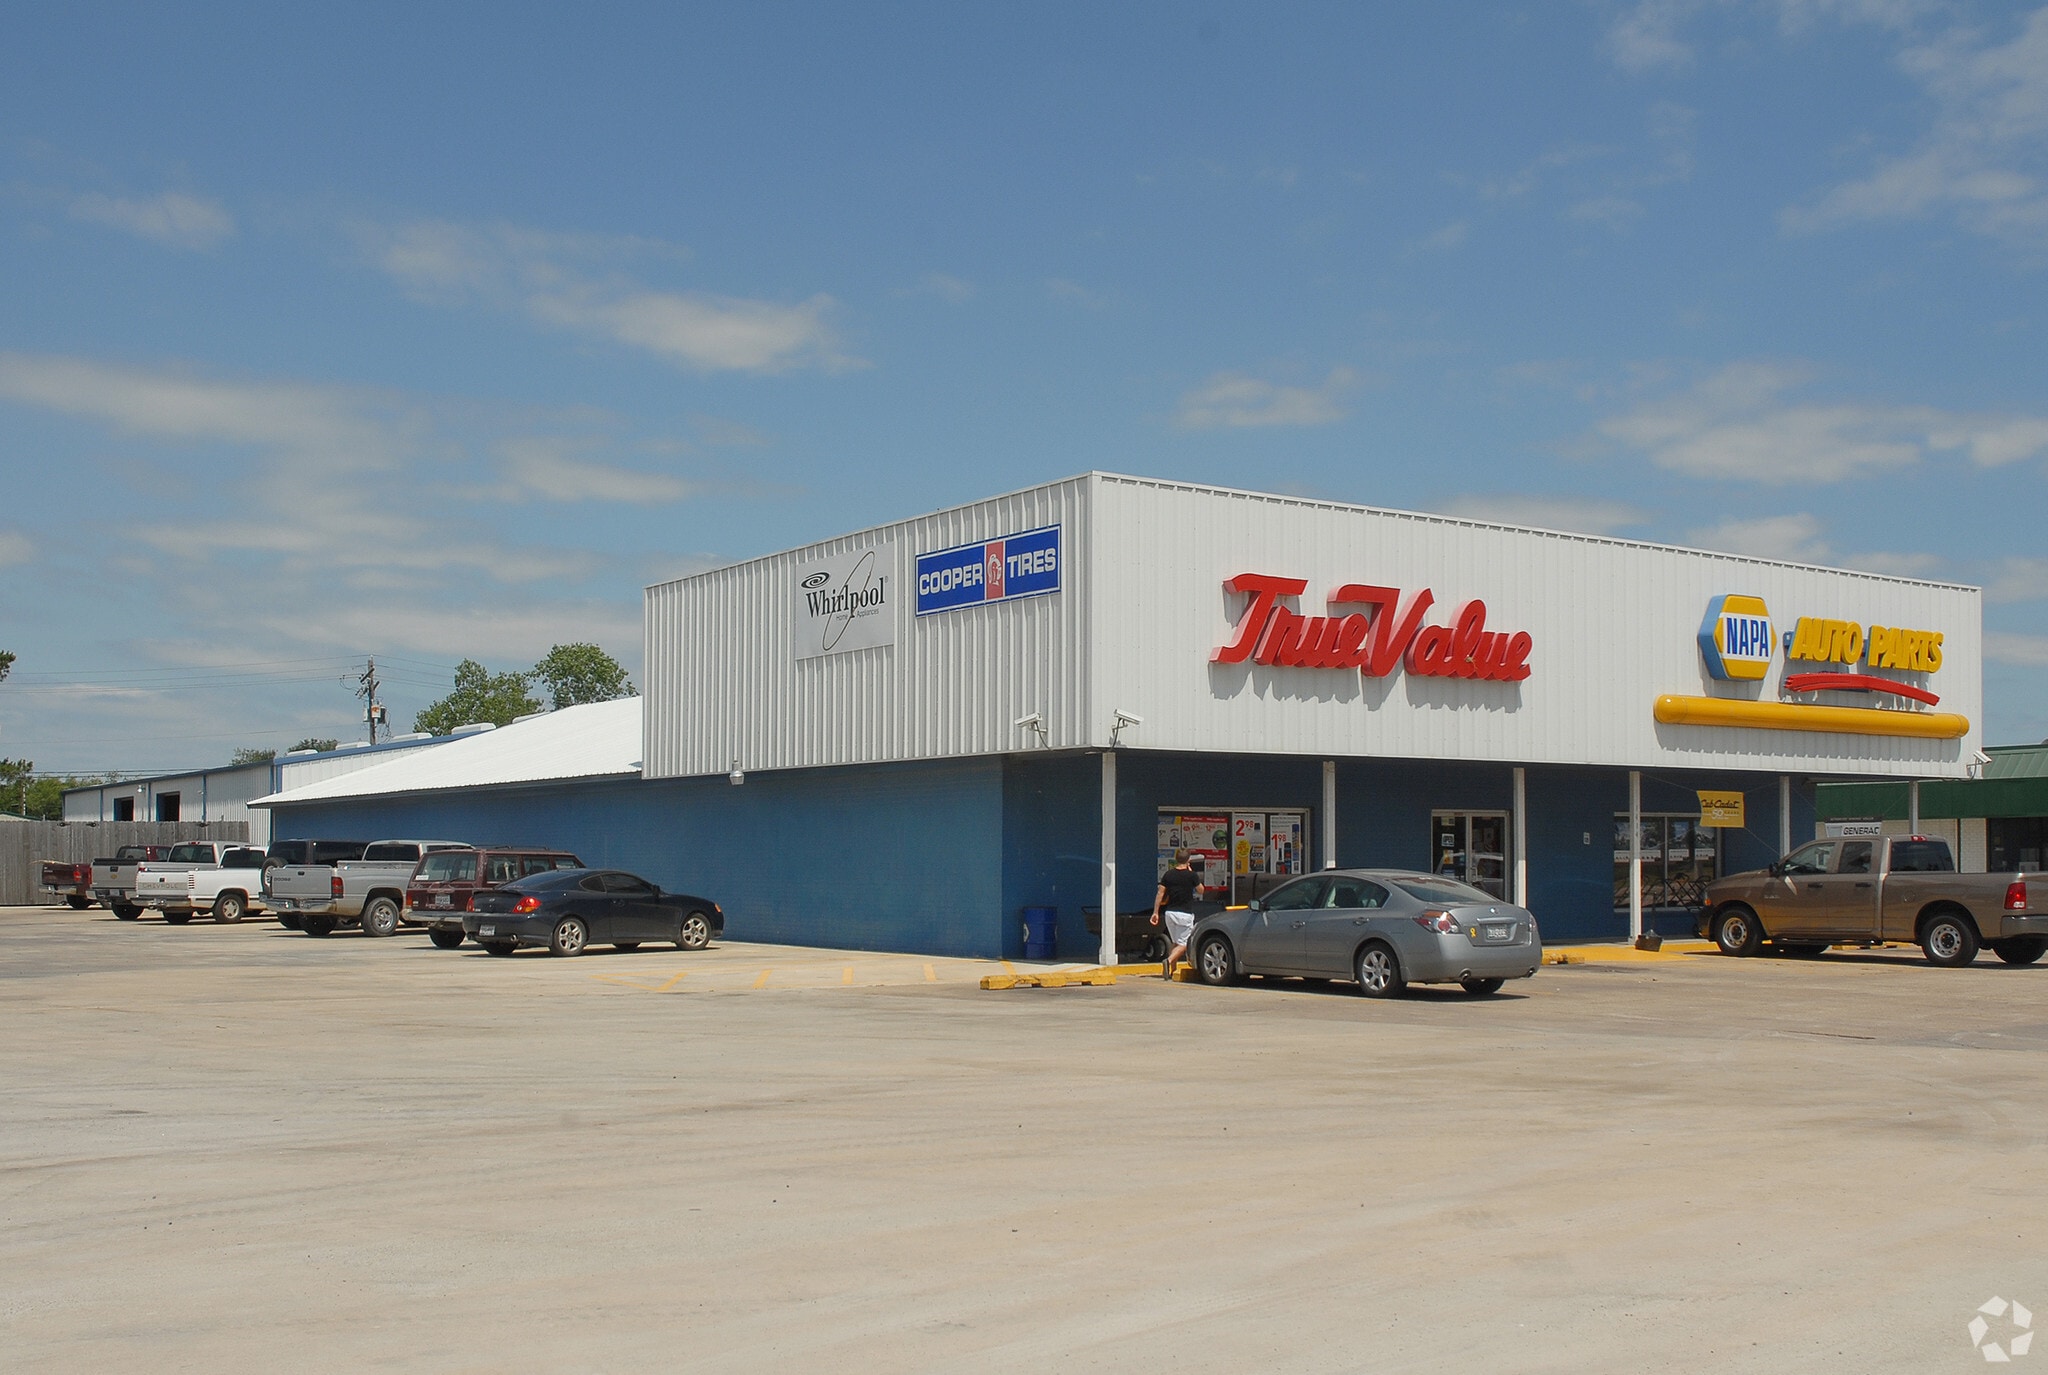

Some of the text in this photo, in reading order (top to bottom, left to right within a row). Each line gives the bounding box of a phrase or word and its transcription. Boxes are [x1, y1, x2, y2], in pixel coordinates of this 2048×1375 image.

[919, 548, 1056, 596] COOPER TIRES
[806, 577, 885, 619] Whirlpool
[1209, 573, 1533, 681] True Value
[1726, 616, 1769, 658] NAPA
[1789, 616, 1944, 673] AUTO PARTS
[1843, 826, 1880, 835] GENERAC
